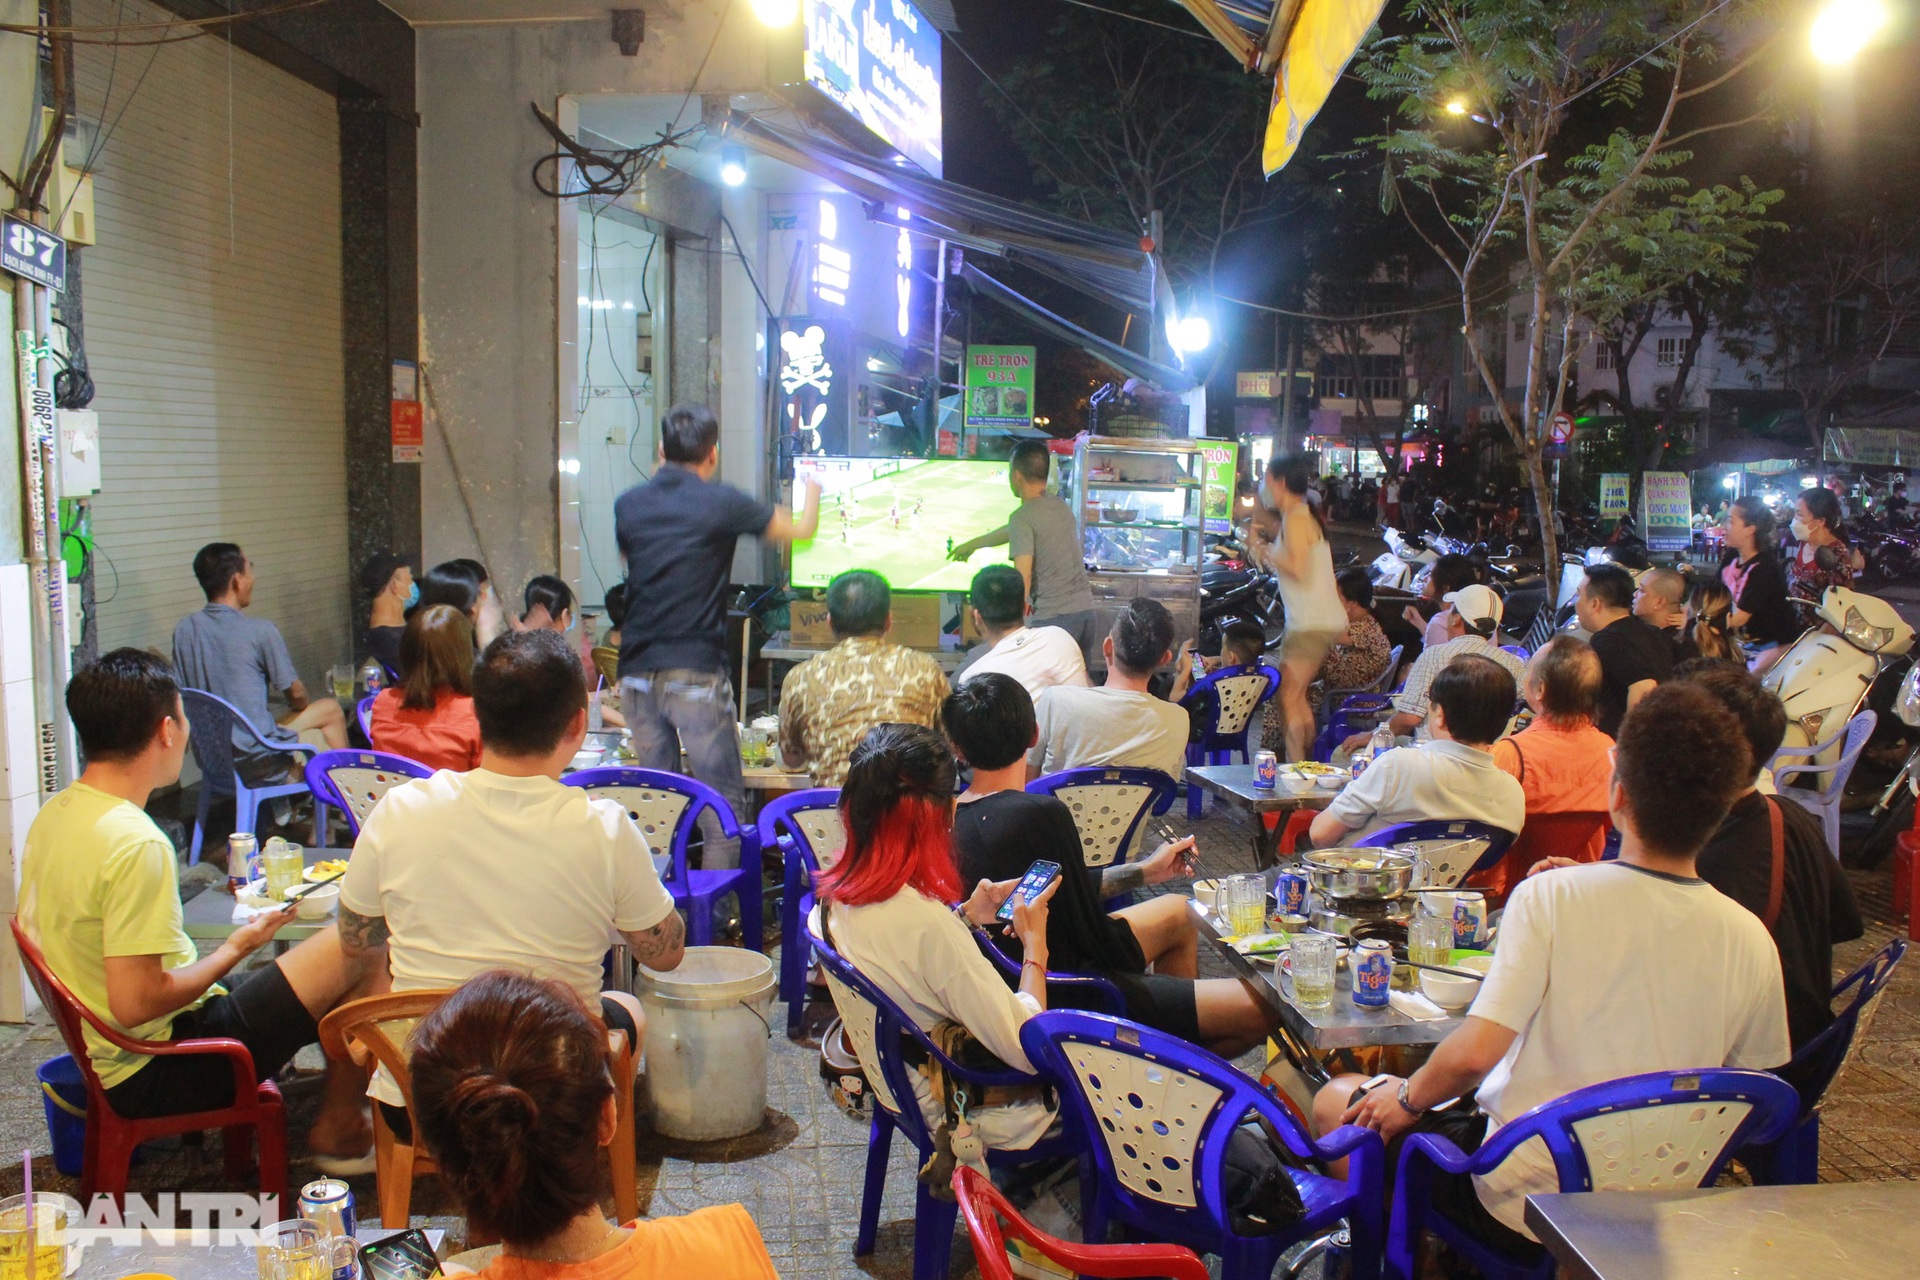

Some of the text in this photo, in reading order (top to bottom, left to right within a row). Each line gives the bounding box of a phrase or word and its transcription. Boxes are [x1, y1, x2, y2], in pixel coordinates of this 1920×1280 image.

[10, 224, 58, 266] 87
[998, 352, 1030, 369] TRỘN
[1205, 445, 1232, 465] RỘN
[1287, 880, 1302, 912] Tiger
[1454, 920, 1477, 936] iger
[1359, 971, 1389, 989] Tiger
